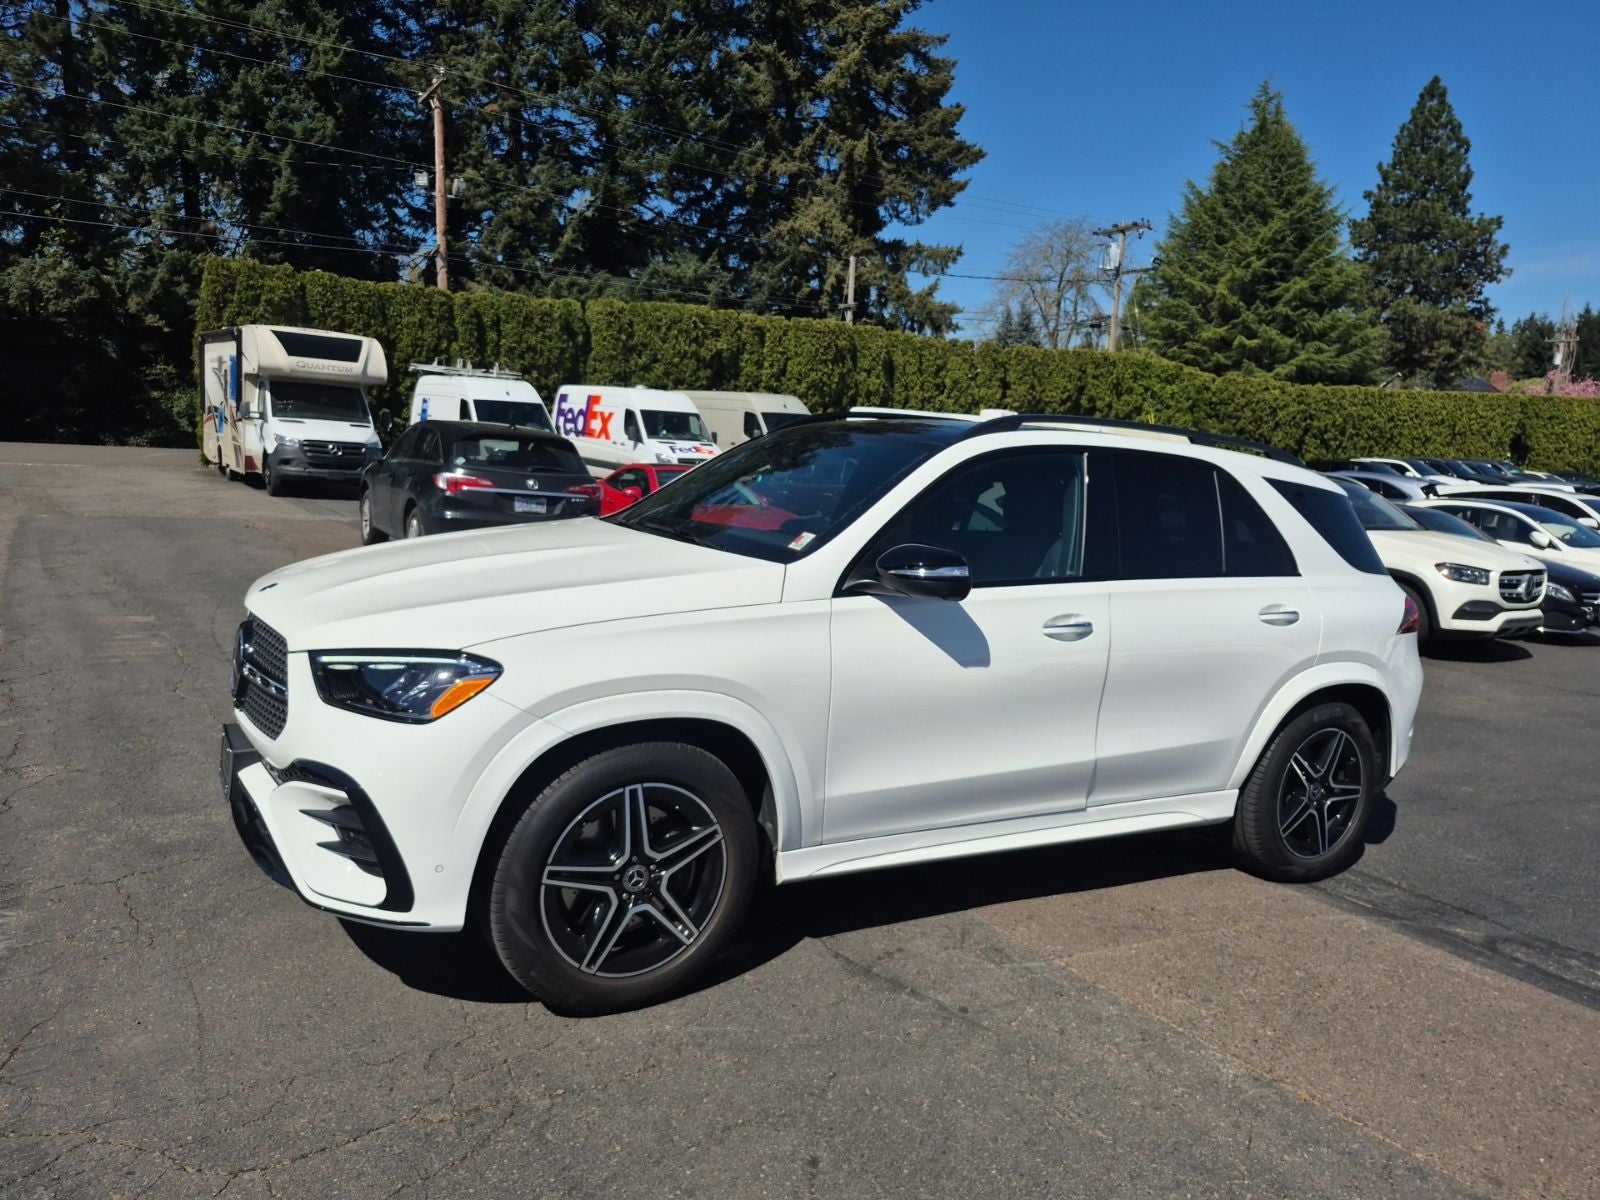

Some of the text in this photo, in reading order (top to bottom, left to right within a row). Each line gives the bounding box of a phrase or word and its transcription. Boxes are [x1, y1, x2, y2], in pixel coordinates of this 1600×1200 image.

[296, 360, 353, 373] QUANTUM
[556, 393, 614, 441] FedEx
[669, 445, 716, 456] FedEx
